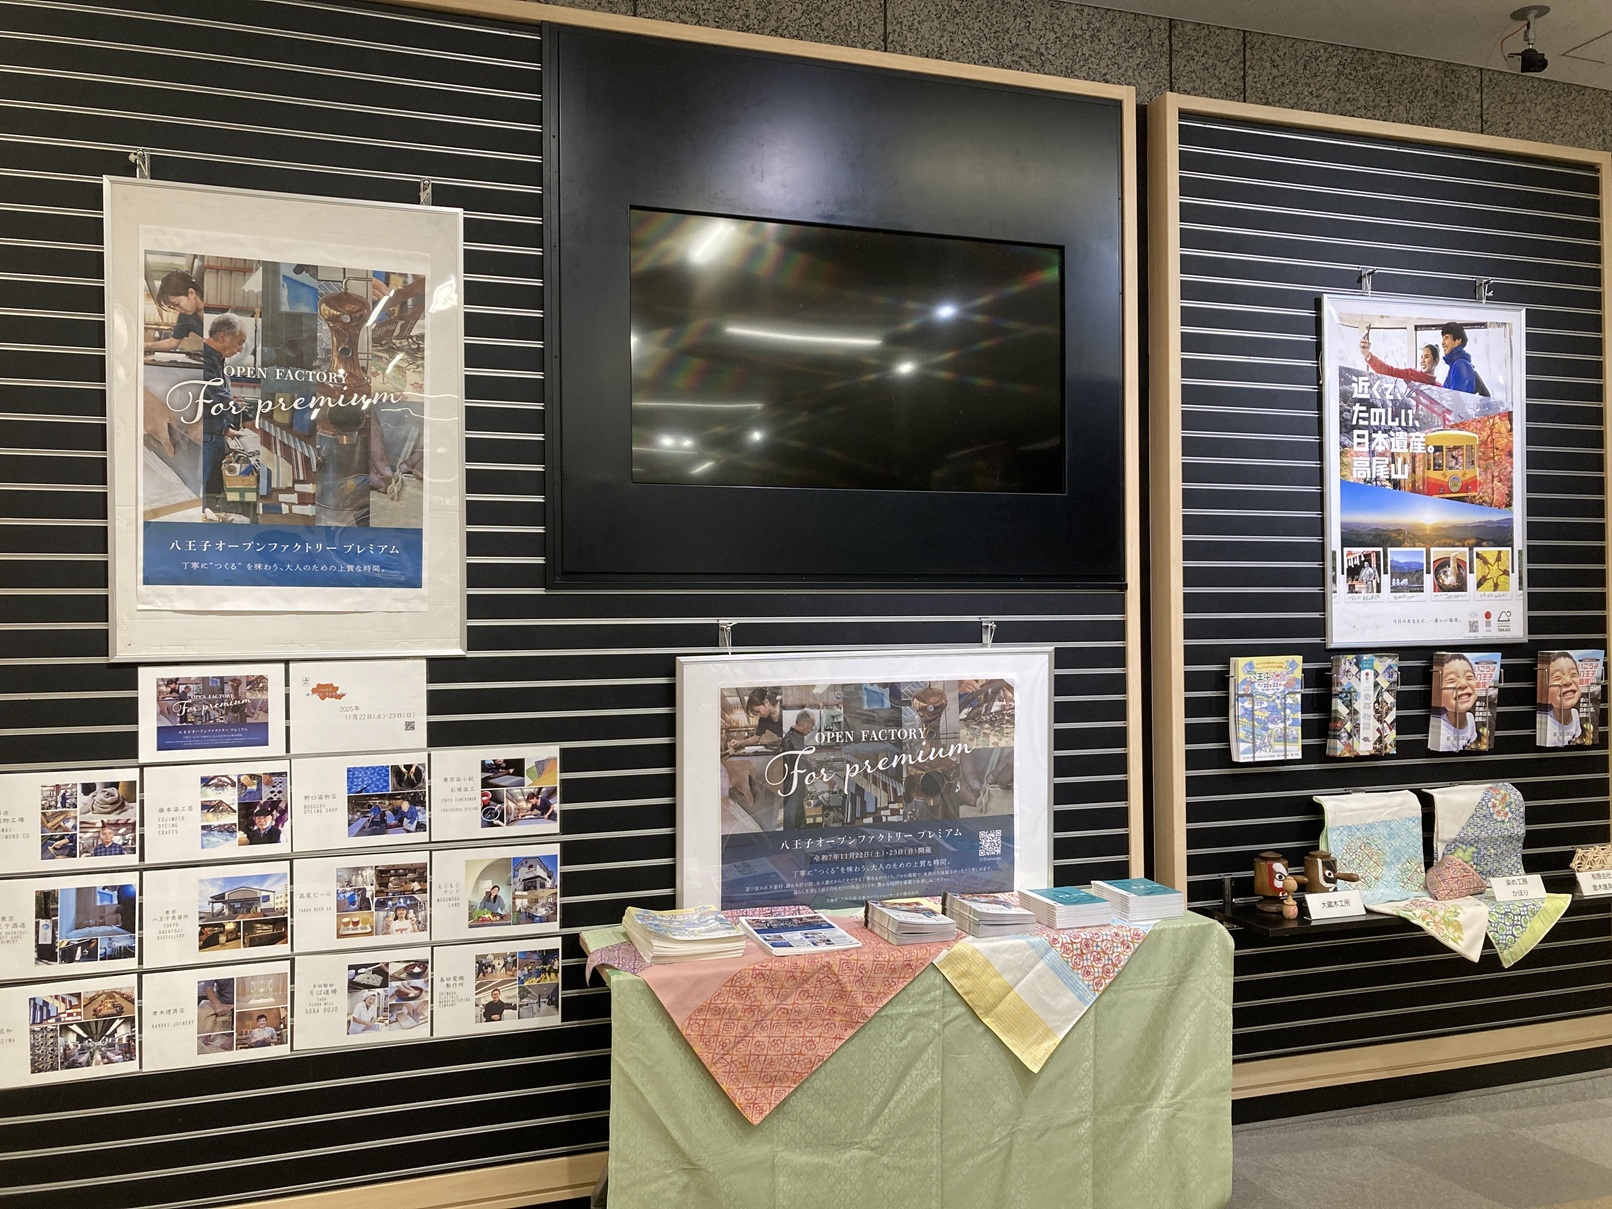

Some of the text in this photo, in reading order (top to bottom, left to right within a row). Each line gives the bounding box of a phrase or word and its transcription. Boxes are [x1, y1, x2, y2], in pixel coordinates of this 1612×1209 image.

[223, 364, 349, 384] OPEN FACTORY
[1352, 376, 1403, 400] 近くて、
[166, 377, 403, 429] For premium
[1352, 403, 1420, 427] たのしい、
[1352, 429, 1435, 454] 日本遺産。
[1352, 457, 1409, 480] 高尾山
[168, 540, 400, 555] 八王子オープンファクトリー プレミアム
[172, 697, 251, 717] For premium
[815, 727, 927, 744] OPEN FACTORY
[764, 740, 973, 797] For premium
[779, 828, 962, 851] 八王子オープンファクトリー プレミアム
[298, 891, 332, 899] 高尾ビール
[323, 1006, 339, 1014] DOJO
